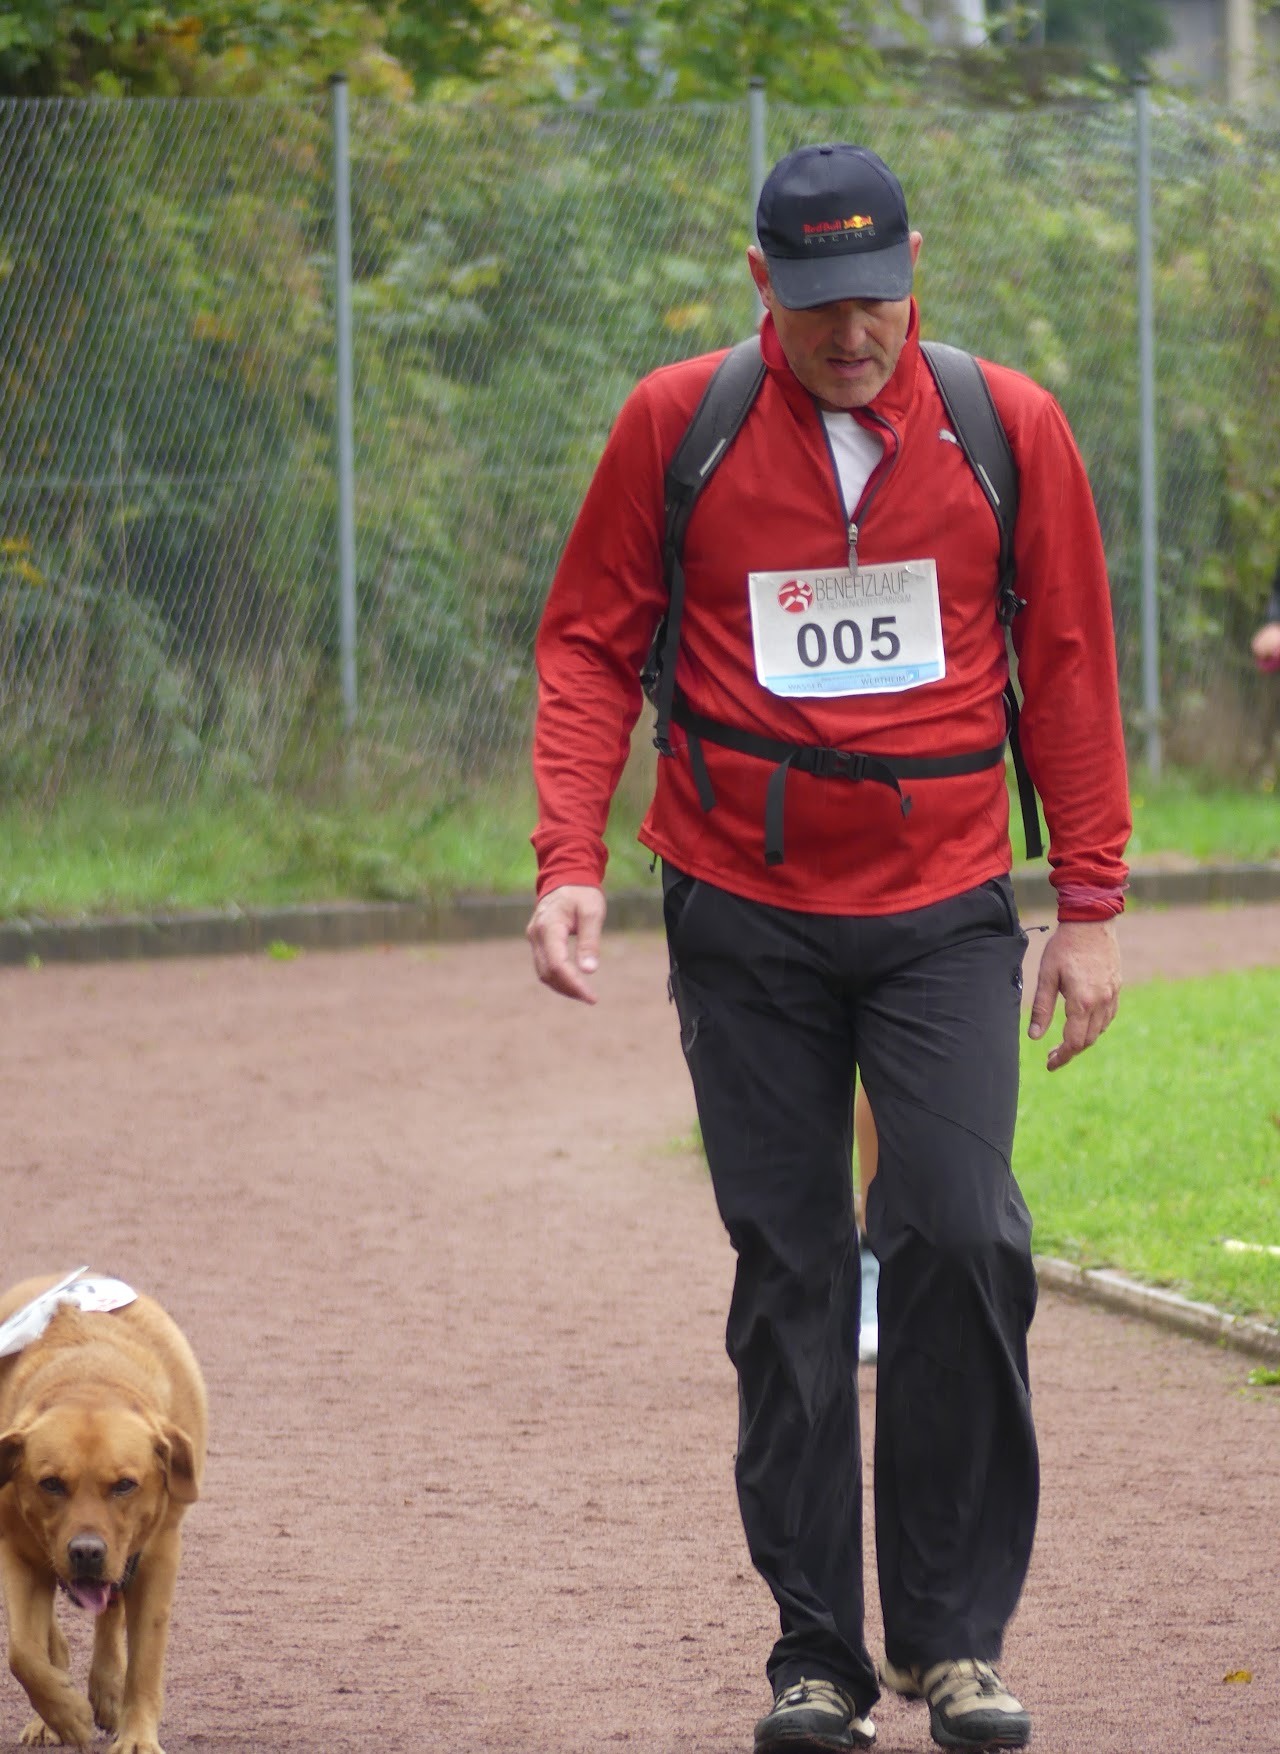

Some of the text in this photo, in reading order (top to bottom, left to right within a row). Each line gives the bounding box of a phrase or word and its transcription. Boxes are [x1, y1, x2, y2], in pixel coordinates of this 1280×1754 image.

[803, 229, 876, 245] RACING
[815, 571, 909, 601] BENEFIZLAUF
[797, 616, 901, 668] 005
[861, 675, 906, 687] WERTHEIM
